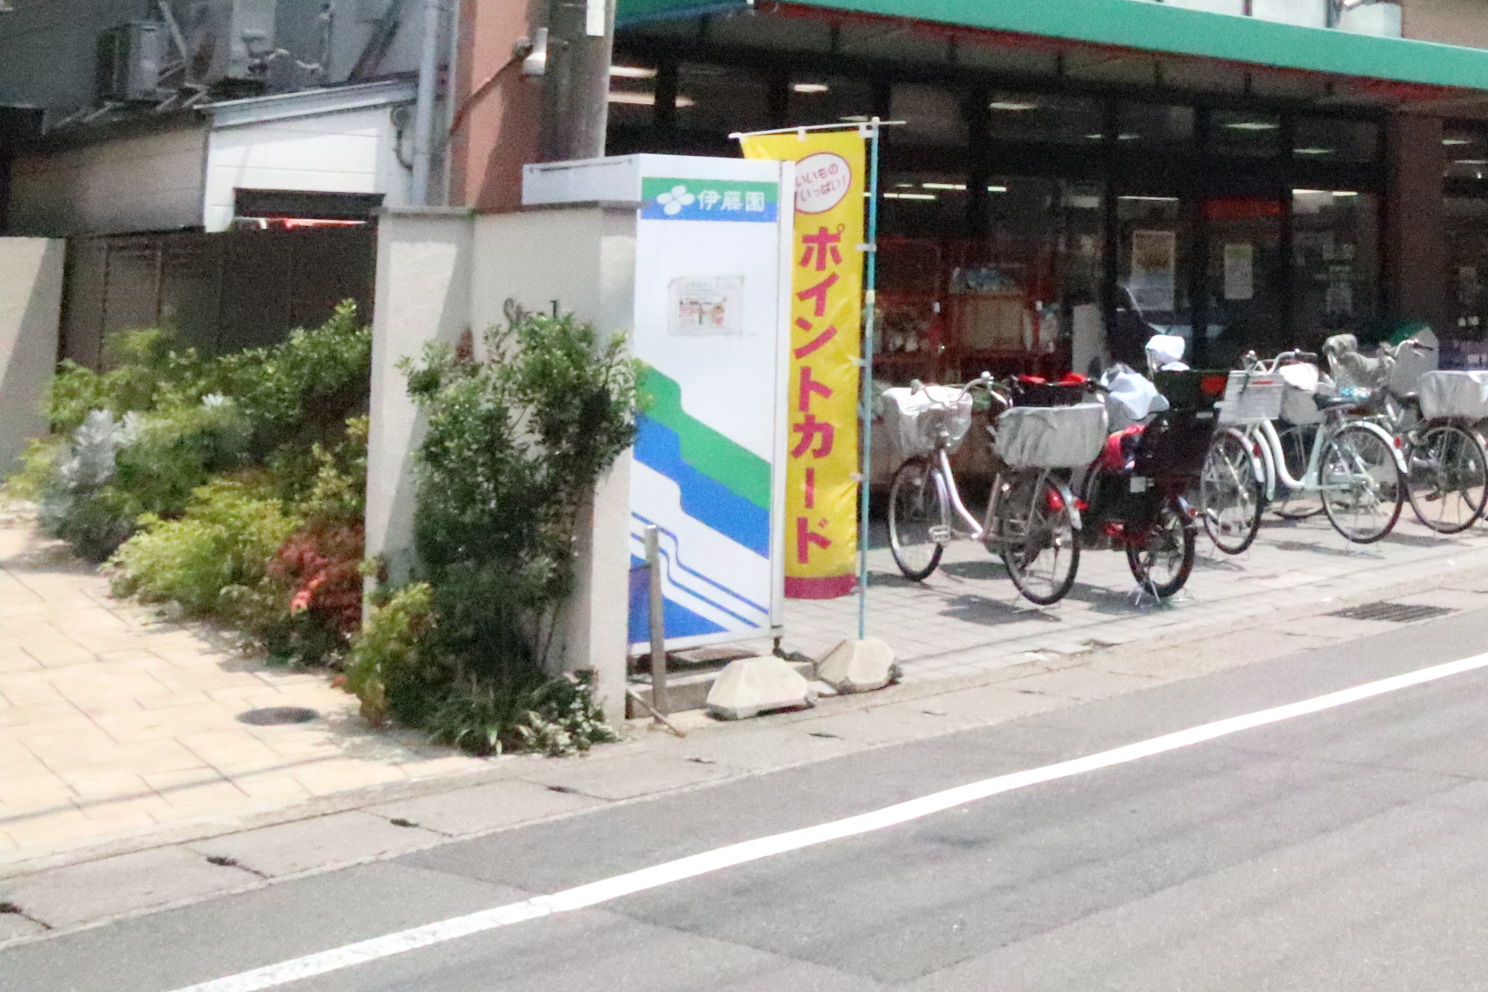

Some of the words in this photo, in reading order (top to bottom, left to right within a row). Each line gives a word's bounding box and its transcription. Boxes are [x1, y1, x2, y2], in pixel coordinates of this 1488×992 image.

[697, 190, 765, 212] 伊藤園
[791, 224, 846, 564] ポイントカード
